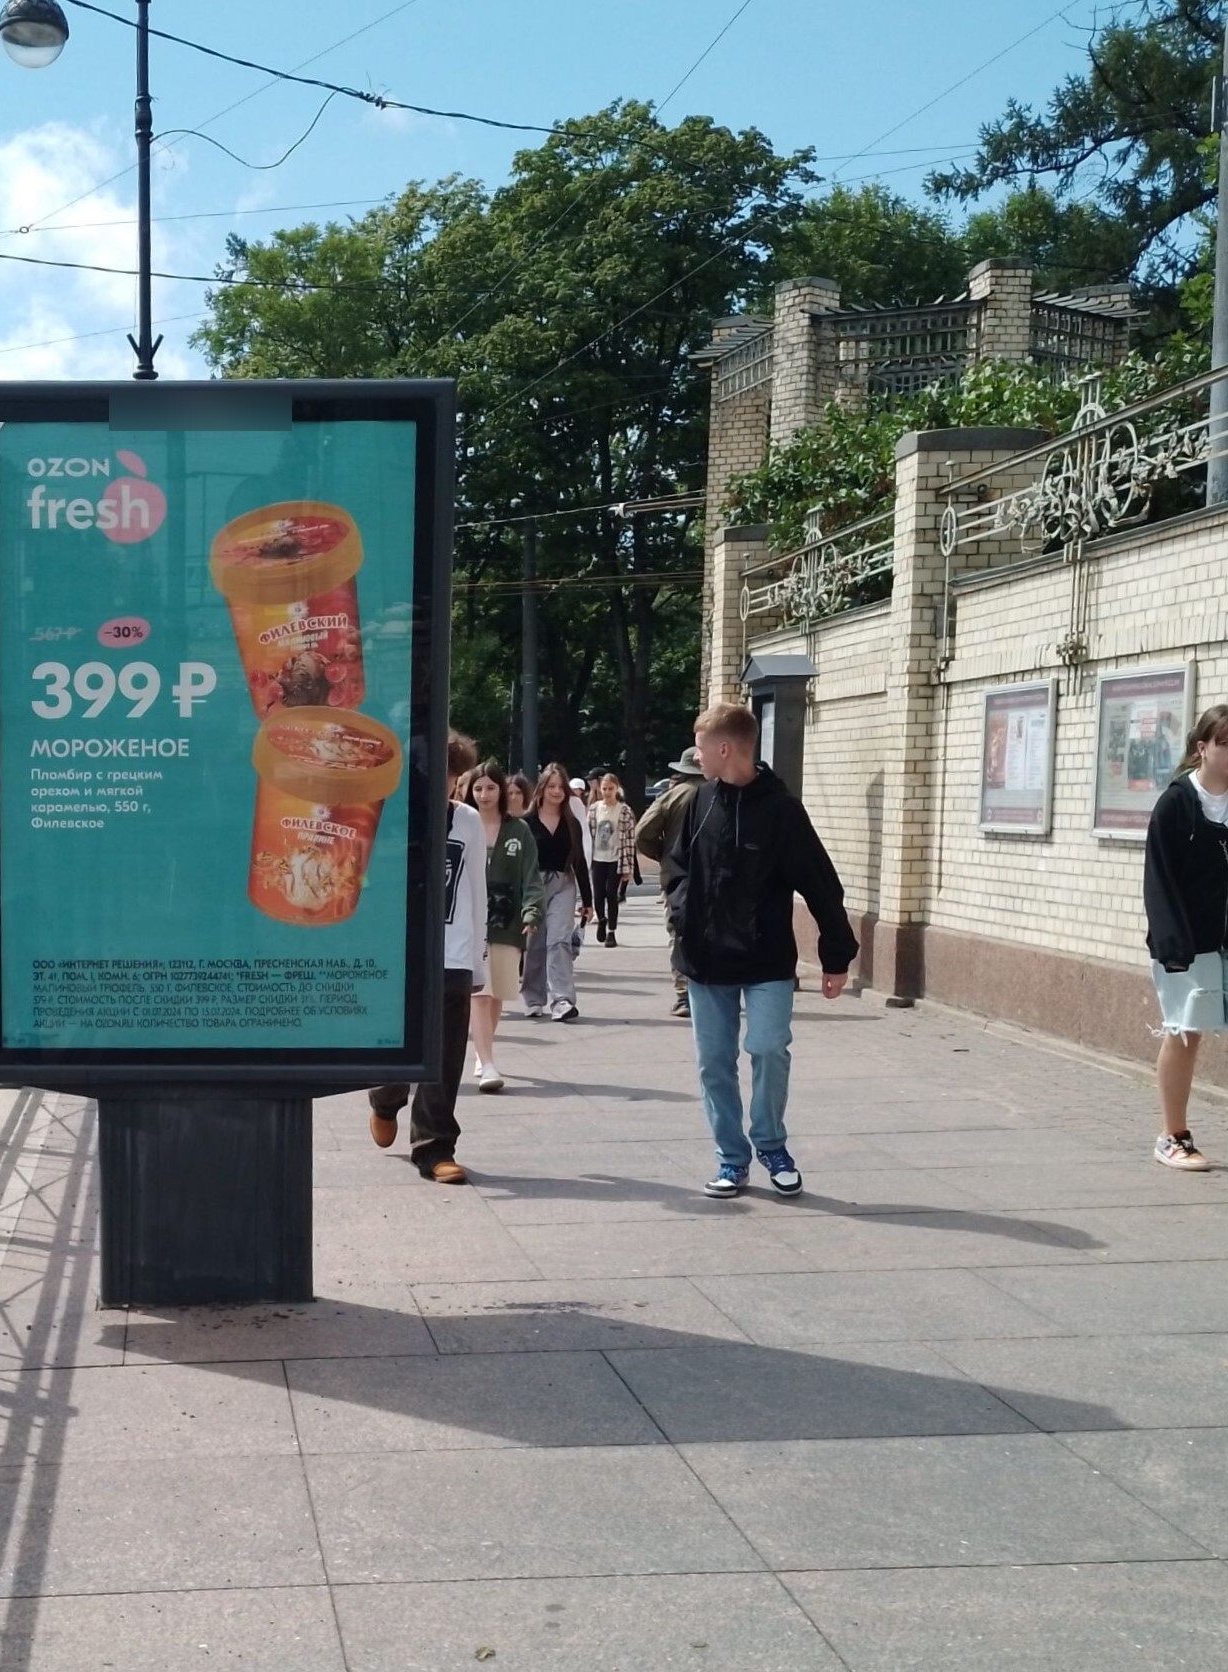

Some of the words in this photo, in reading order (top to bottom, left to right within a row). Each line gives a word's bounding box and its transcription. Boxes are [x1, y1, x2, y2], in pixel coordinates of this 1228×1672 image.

[27, 458, 110, 477] OZON
[27, 485, 150, 529] fresh
[259, 613, 348, 645] ФИЛЕВСКИЙ
[31, 661, 162, 720] 399
[30, 738, 190, 758] МОРОЖЕНОЕ
[30, 768, 92, 782] Пломбир
[96, 771, 103, 780] с
[107, 770, 164, 783] грецким
[30, 787, 80, 798] орехом
[84, 788, 92, 796] и
[96, 785, 143, 796] мягкой
[30, 803, 110, 815] карамелью,
[114, 801, 139, 812] 550
[142, 804, 151, 814] г,
[30, 817, 105, 829] Филевское
[281, 817, 356, 839] ФИЛЕВСКОЕ
[32, 960, 55, 969] ООО
[254, 959, 323, 968] ПРЕСНЕНСКАЯ
[143, 971, 167, 980] ОГРН
[237, 983, 296, 992] СТОИМОСТЬ
[315, 982, 354, 992] СКИДКИ
[58, 995, 116, 1004] СТОИМОСТЬ
[118, 995, 151, 1004] ПОСЛЕ
[245, 1006, 301, 1016] ПОДРОБНЕЕ
[137, 1019, 199, 1028] КОЛИЧЕСТВО
